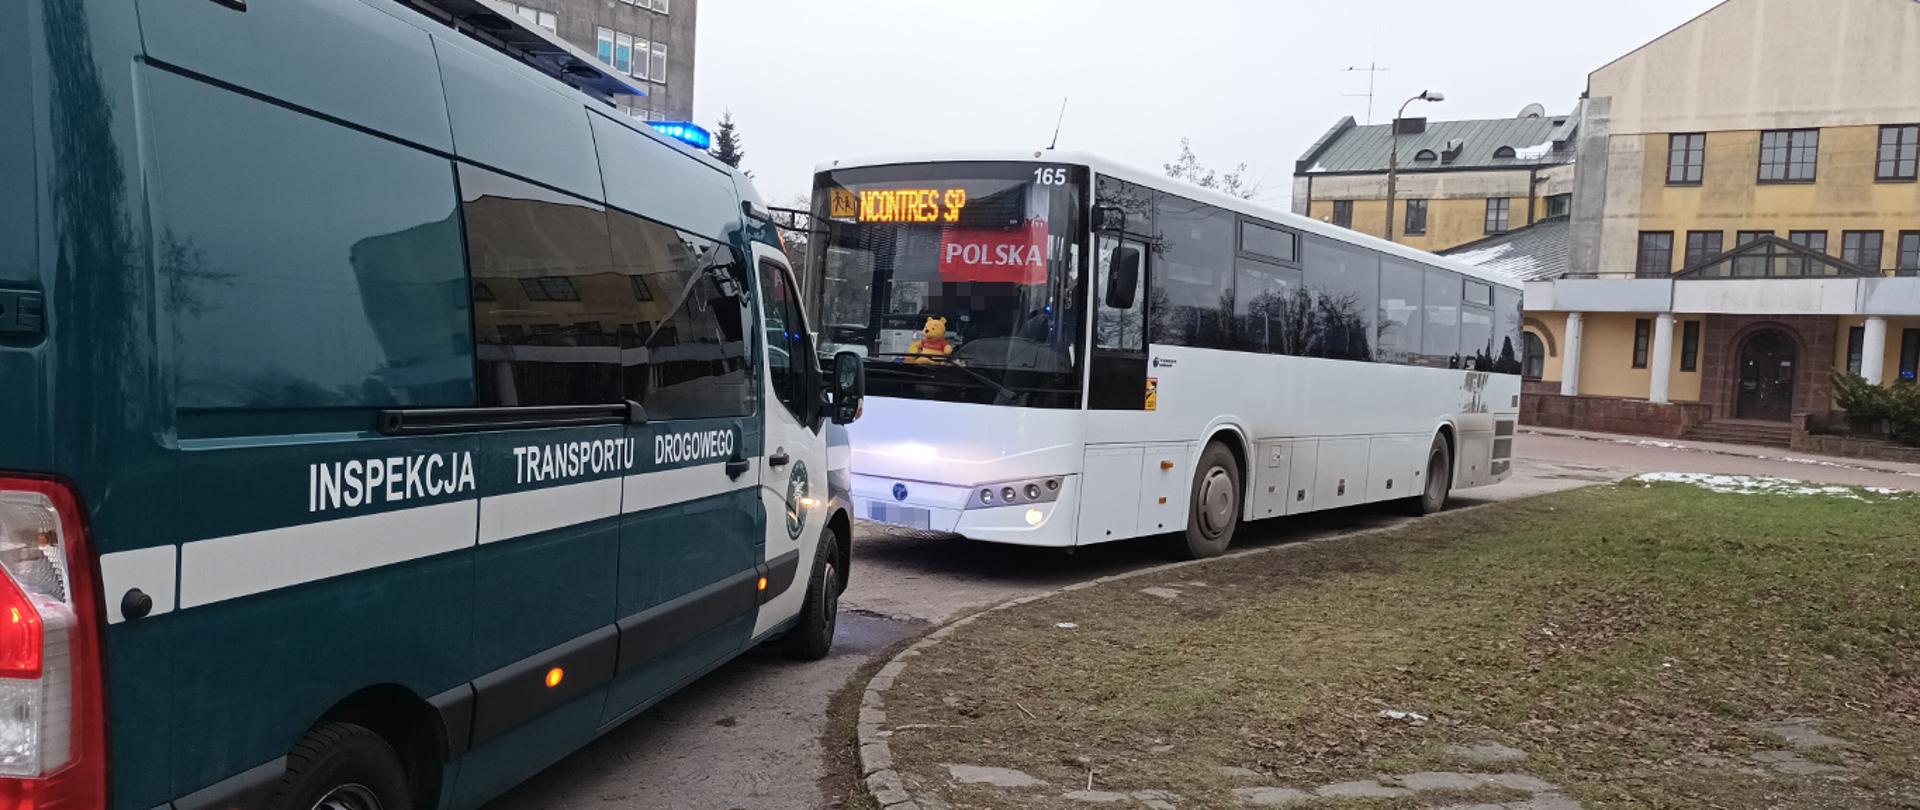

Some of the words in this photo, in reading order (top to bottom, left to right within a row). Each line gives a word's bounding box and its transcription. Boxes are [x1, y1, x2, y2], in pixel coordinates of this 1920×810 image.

[1033, 168, 1066, 185] 165
[860, 191, 939, 222] NCONTRES
[945, 190, 966, 222] SP
[946, 244, 1043, 267] POLSKA
[309, 451, 476, 512] INSPEKCJA
[514, 438, 635, 484] TRANSPORTU
[655, 430, 735, 465] DROGOWEGO
